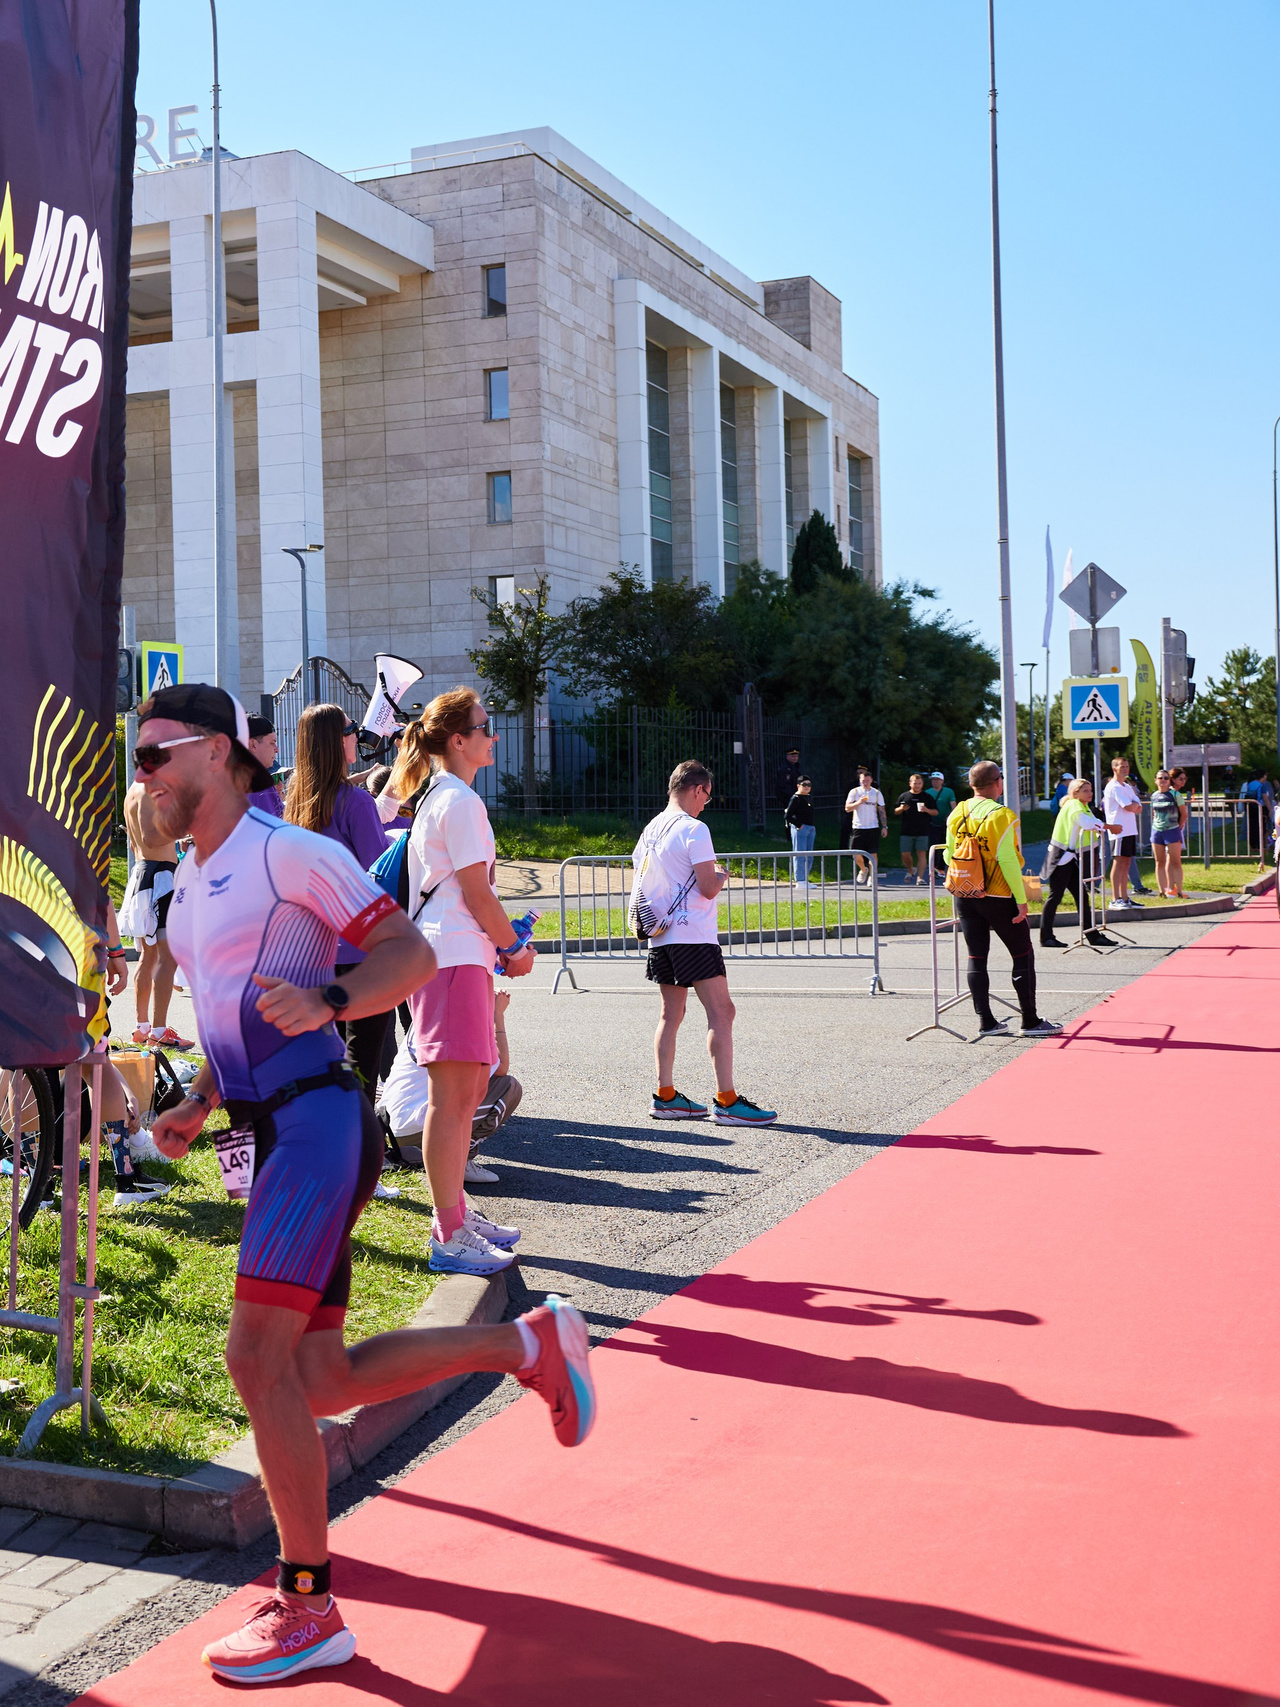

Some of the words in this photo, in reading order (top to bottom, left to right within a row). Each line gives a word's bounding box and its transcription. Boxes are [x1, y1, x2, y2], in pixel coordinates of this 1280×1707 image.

[134, 105, 198, 167] RE
[219, 1150, 250, 1173] 149
[279, 1621, 321, 1654] HOKA
